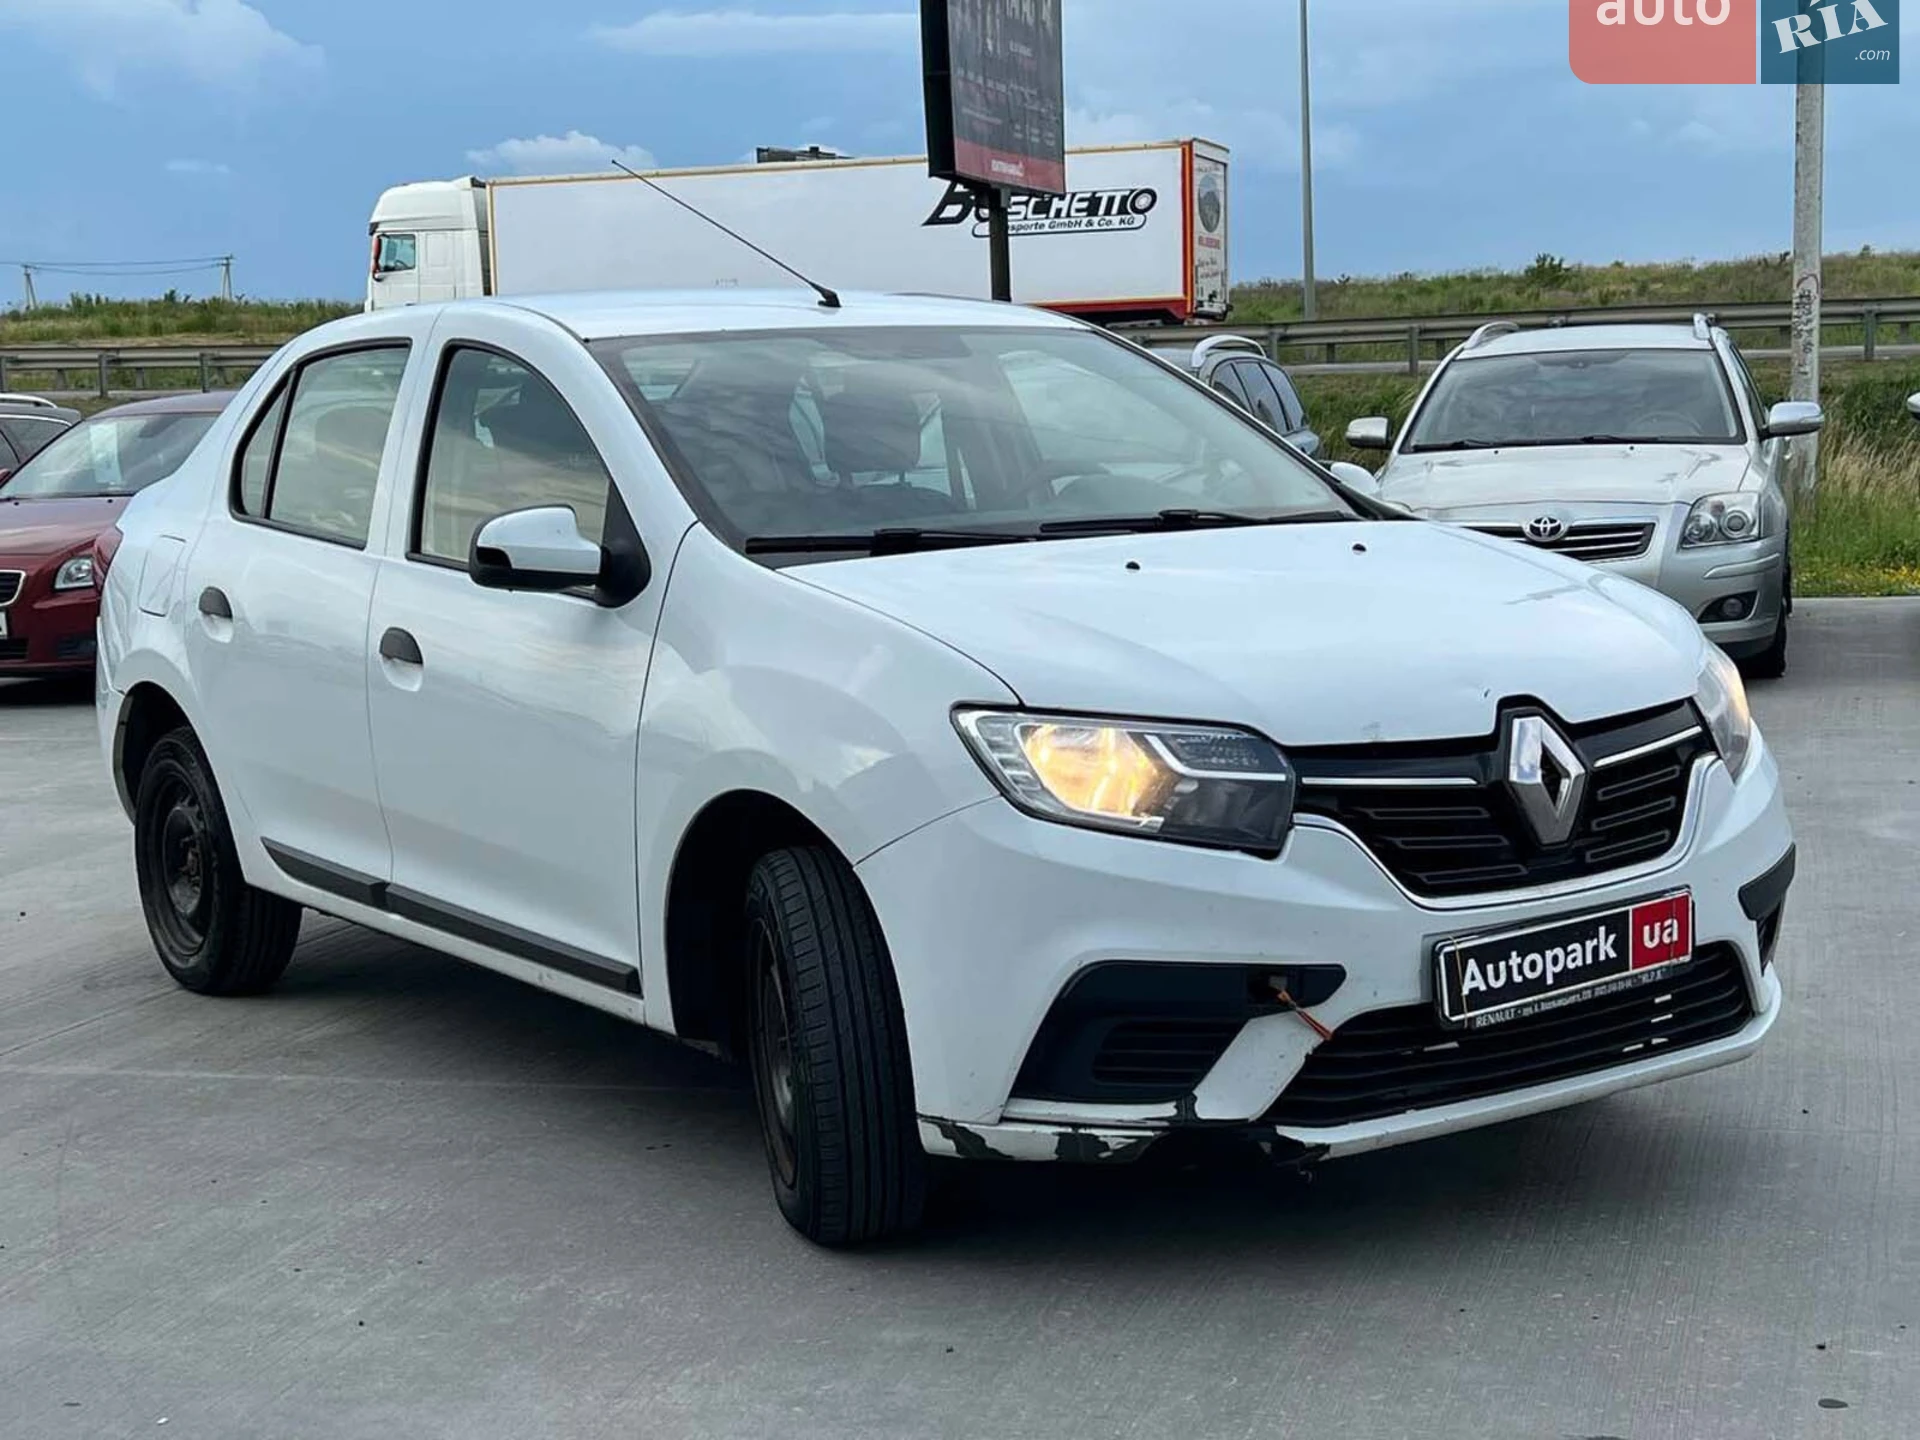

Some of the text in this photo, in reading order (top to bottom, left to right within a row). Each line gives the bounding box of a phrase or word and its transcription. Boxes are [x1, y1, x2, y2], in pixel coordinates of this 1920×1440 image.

[1008, 216, 1135, 232] sporte GmbH & Co. KG
[1462, 925, 1617, 995] Autopark
[1642, 917, 1679, 949] ua
[1475, 1007, 1517, 1029] RENAULT
